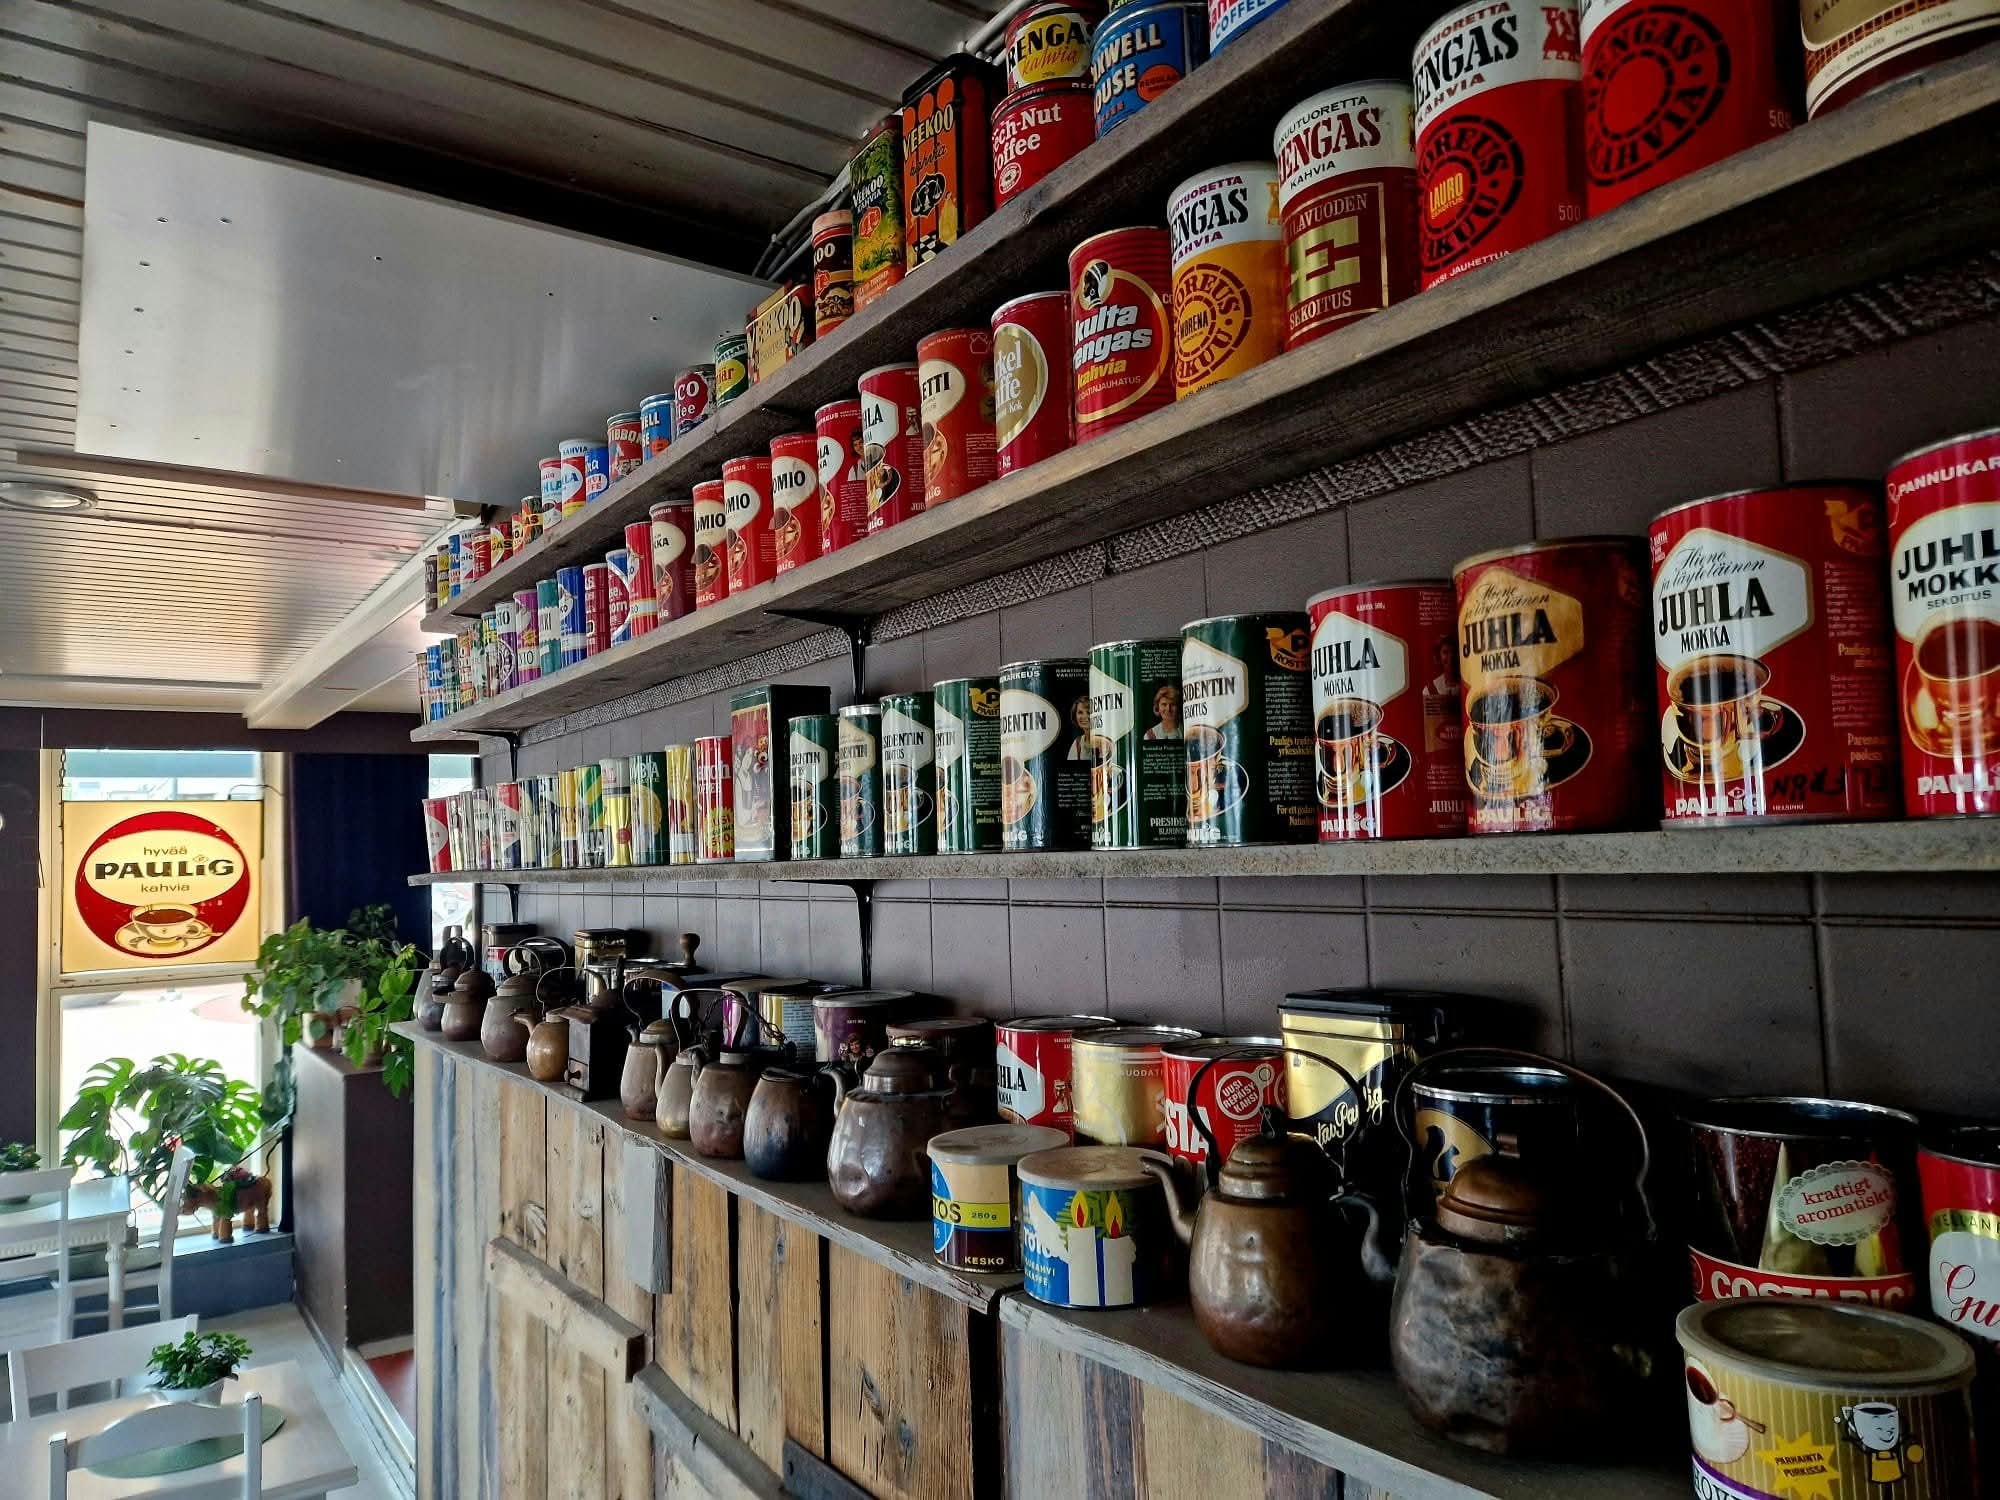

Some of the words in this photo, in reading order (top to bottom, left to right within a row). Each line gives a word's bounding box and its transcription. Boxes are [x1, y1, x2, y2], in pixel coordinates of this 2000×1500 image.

[903, 103, 954, 161] VEEKOO
[1290, 160, 1336, 190] KAHVIA
[852, 174, 884, 208] VEEKOO
[1429, 172, 1464, 214] LAURO
[1074, 303, 1139, 347] kulta
[1289, 289, 1352, 330] SEKOITUS
[1077, 357, 1127, 390] kahvia
[1658, 577, 1775, 637] JUHLA
[1927, 589, 1992, 610] SEKOITUS
[1463, 608, 1558, 659] JUHLA
[1681, 624, 1731, 654] MOKKA
[1312, 637, 1380, 681] JUHLA
[1481, 651, 1521, 673] MOKKA
[1323, 676, 1355, 698] MOKKA
[143, 846, 188, 857] hyvää
[141, 883, 190, 893] kahvia
[1222, 1080, 1242, 1096] UUSI
[1233, 1091, 1259, 1113] KANSI
[1803, 1175, 1873, 1207] kraftigt
[1796, 1188, 1891, 1226] aromatiskt
[964, 1255, 1005, 1266] KESKO
[1784, 1465, 1828, 1479] PURKISSA
